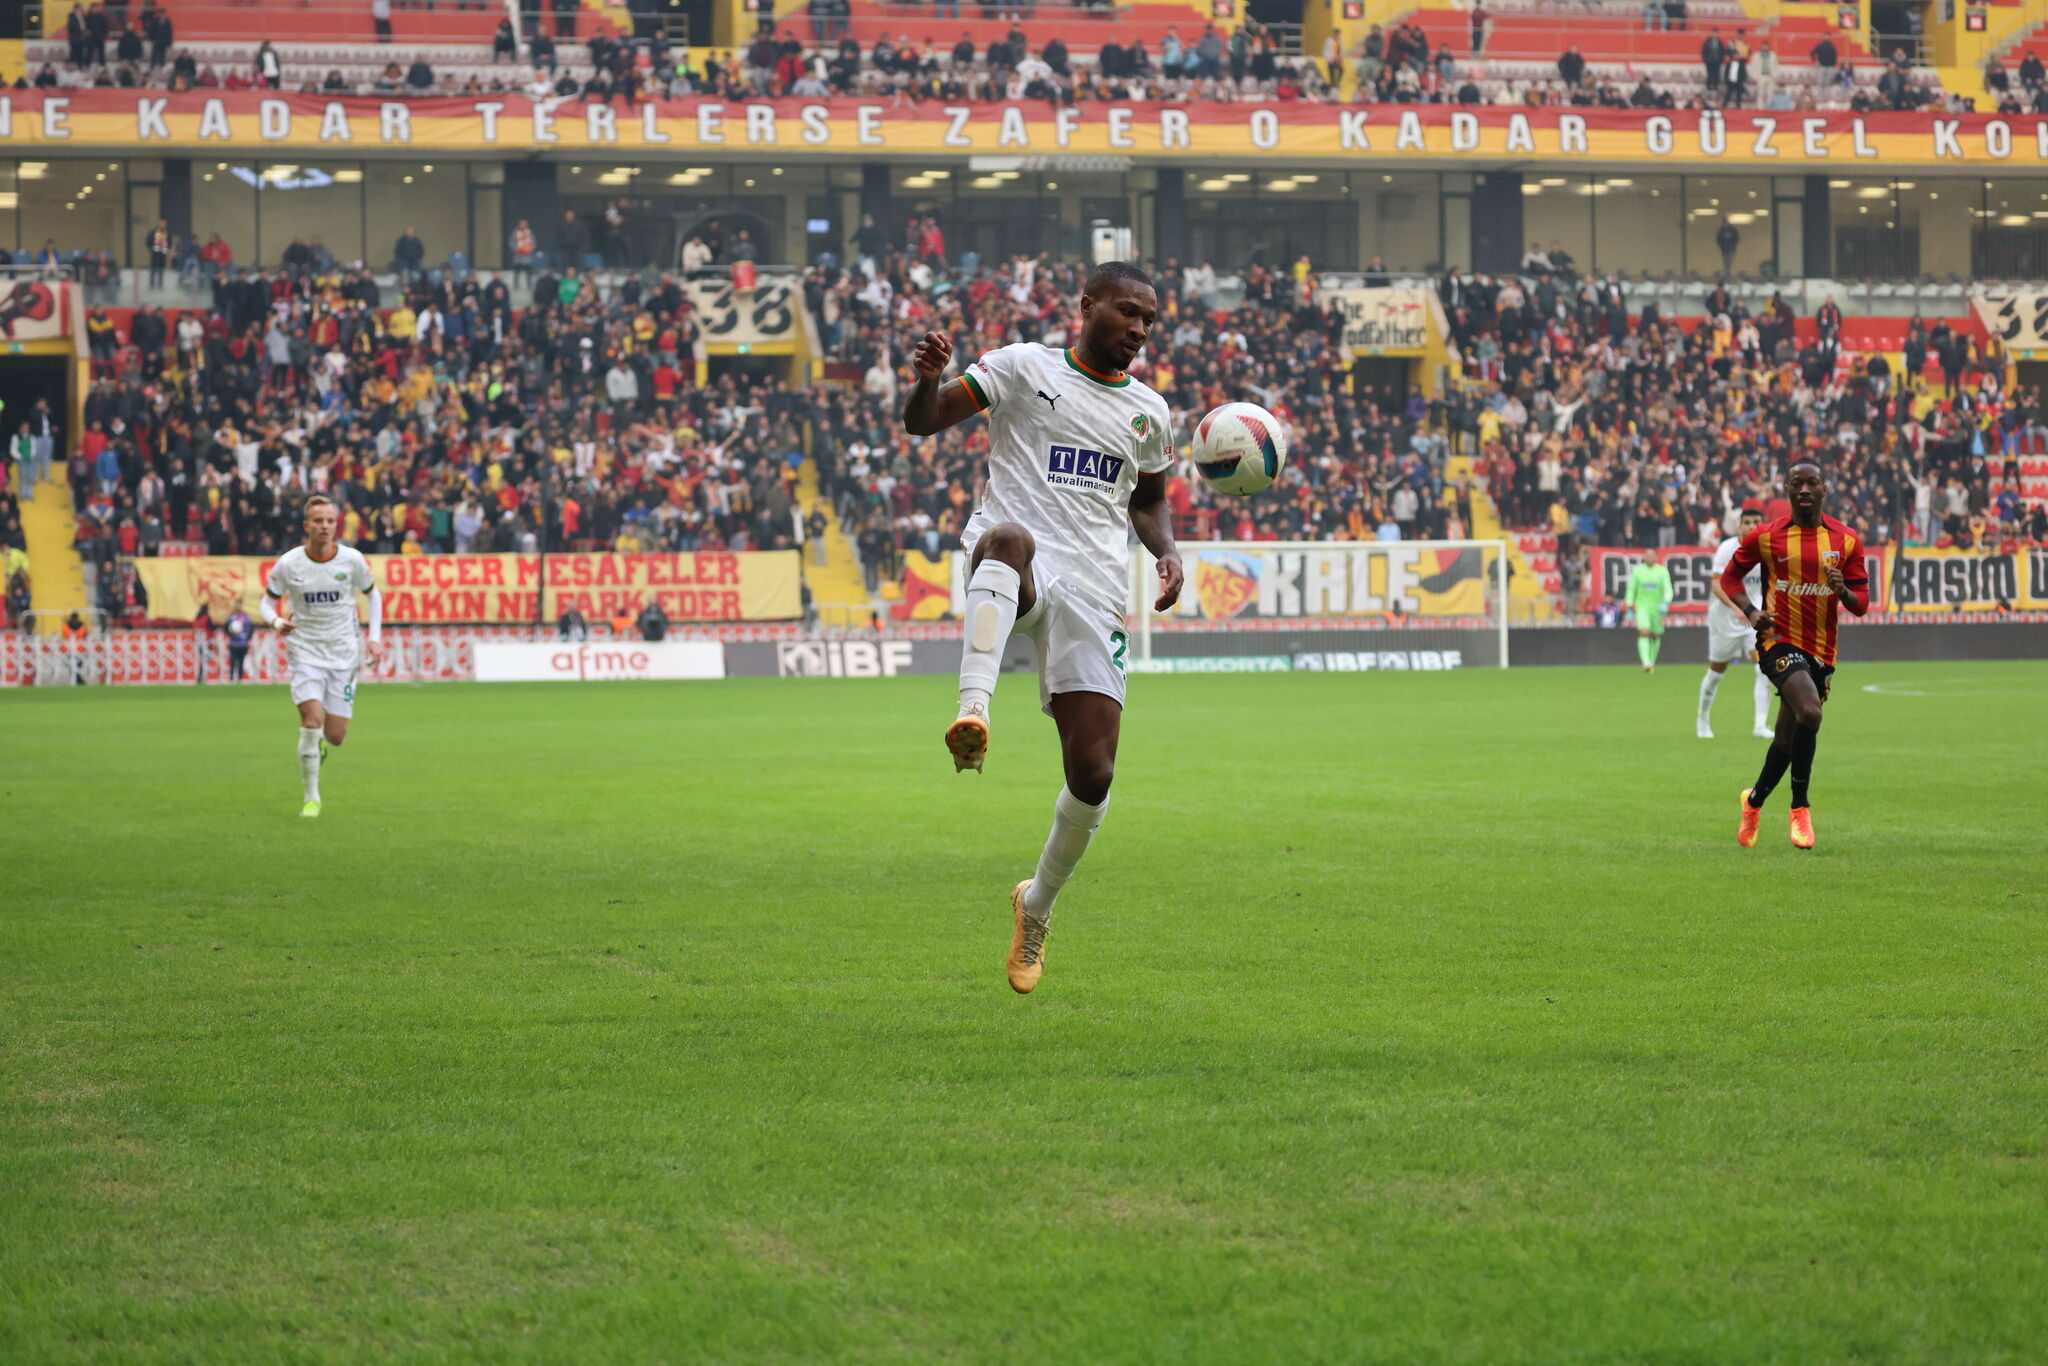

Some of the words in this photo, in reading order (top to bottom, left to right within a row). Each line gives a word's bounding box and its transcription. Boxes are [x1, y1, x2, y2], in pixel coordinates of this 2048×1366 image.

[136, 98, 411, 142] KADAR
[474, 101, 886, 147] TERLERSE
[943, 105, 1191, 148] ZAFER
[1250, 108, 1280, 149] O
[1338, 110, 1590, 152] KADAR
[1645, 107, 1879, 157] GÜZEL
[1054, 450, 1119, 478] TAV
[516, 552, 740, 587] MESAFELER
[1257, 549, 1421, 616] KALE
[555, 590, 645, 619] FARK
[655, 590, 742, 620] EDER
